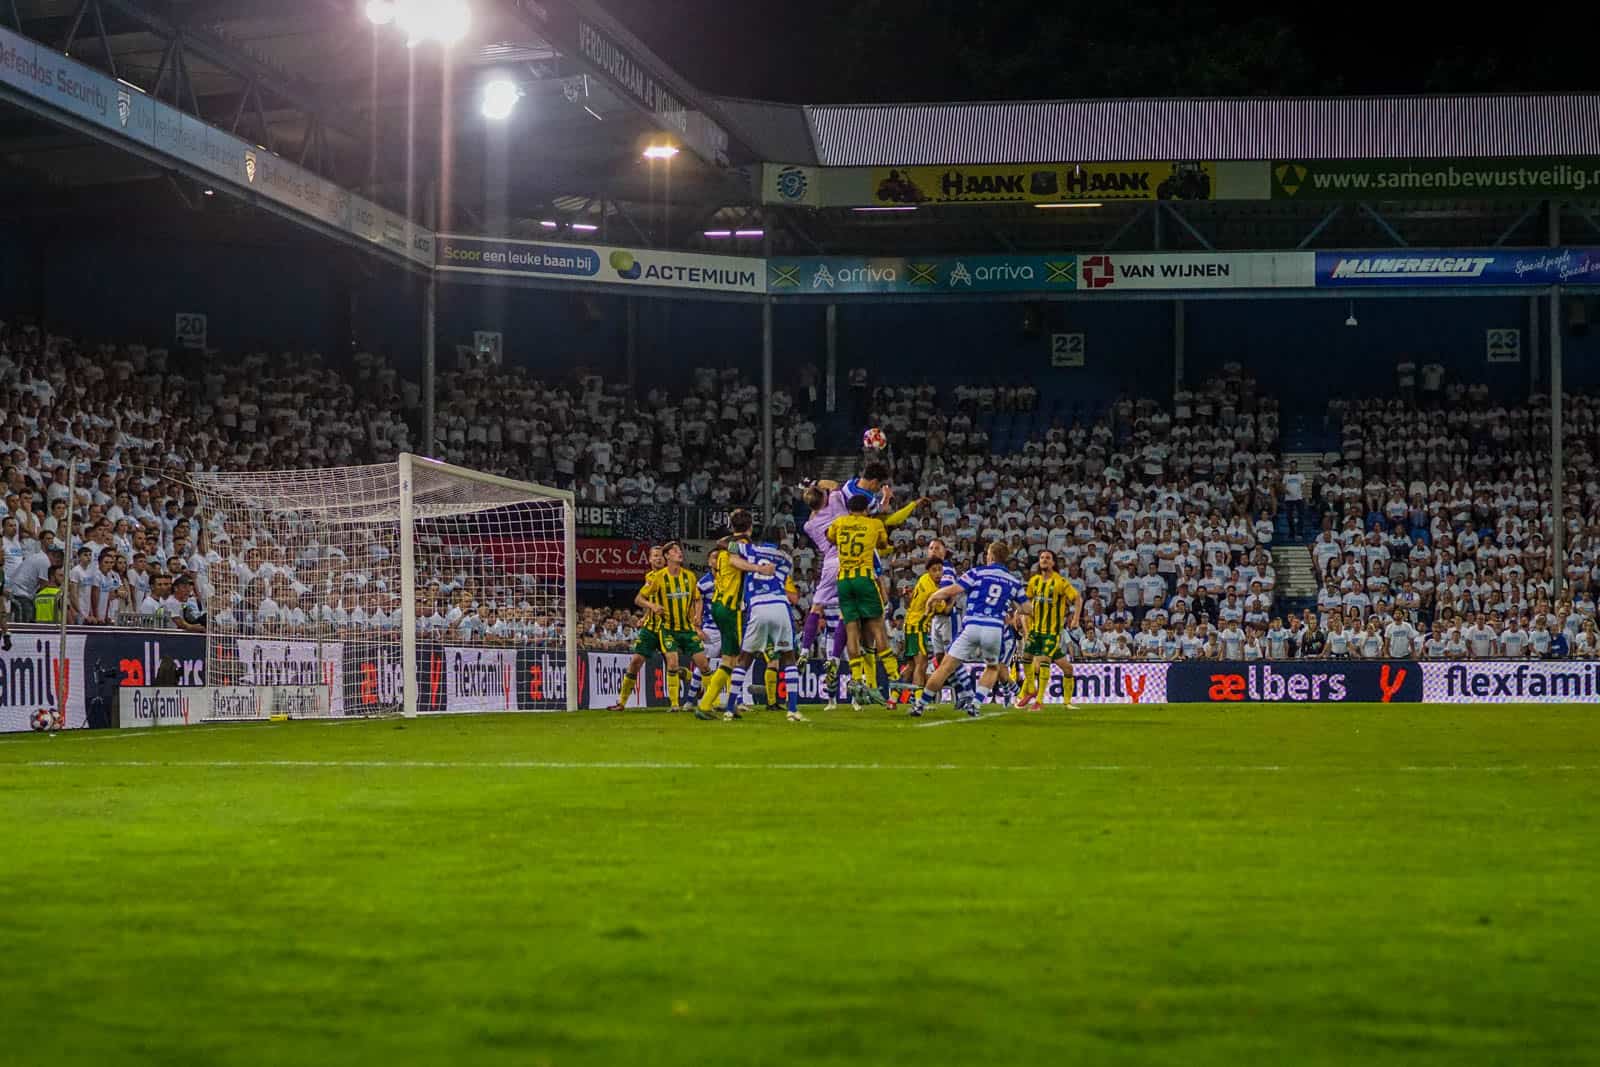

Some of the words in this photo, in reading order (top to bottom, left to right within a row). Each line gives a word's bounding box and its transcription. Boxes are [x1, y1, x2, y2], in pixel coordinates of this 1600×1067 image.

[445, 246, 481, 262] Scoor
[483, 252, 506, 263] een
[508, 250, 541, 266] leuke
[543, 253, 574, 268] baan
[576, 256, 591, 271] bij
[1331, 257, 1496, 279] MAINFREIGHT
[645, 264, 756, 287] ACTEMIUM
[838, 264, 896, 282] arriva
[975, 263, 1034, 281] arriva
[1120, 265, 1158, 278] VAN
[1162, 264, 1229, 278] WIJNEN
[180, 317, 204, 336] 20
[1055, 336, 1083, 352] 22
[1490, 330, 1518, 348] 23
[562, 507, 625, 525] NIBET
[839, 532, 864, 557] 26
[575, 547, 624, 565] ACK'S
[985, 583, 1003, 606] 9
[253, 645, 334, 714] flexfamiy
[454, 652, 511, 710] flexfamily
[134, 689, 190, 725] flexfamily
